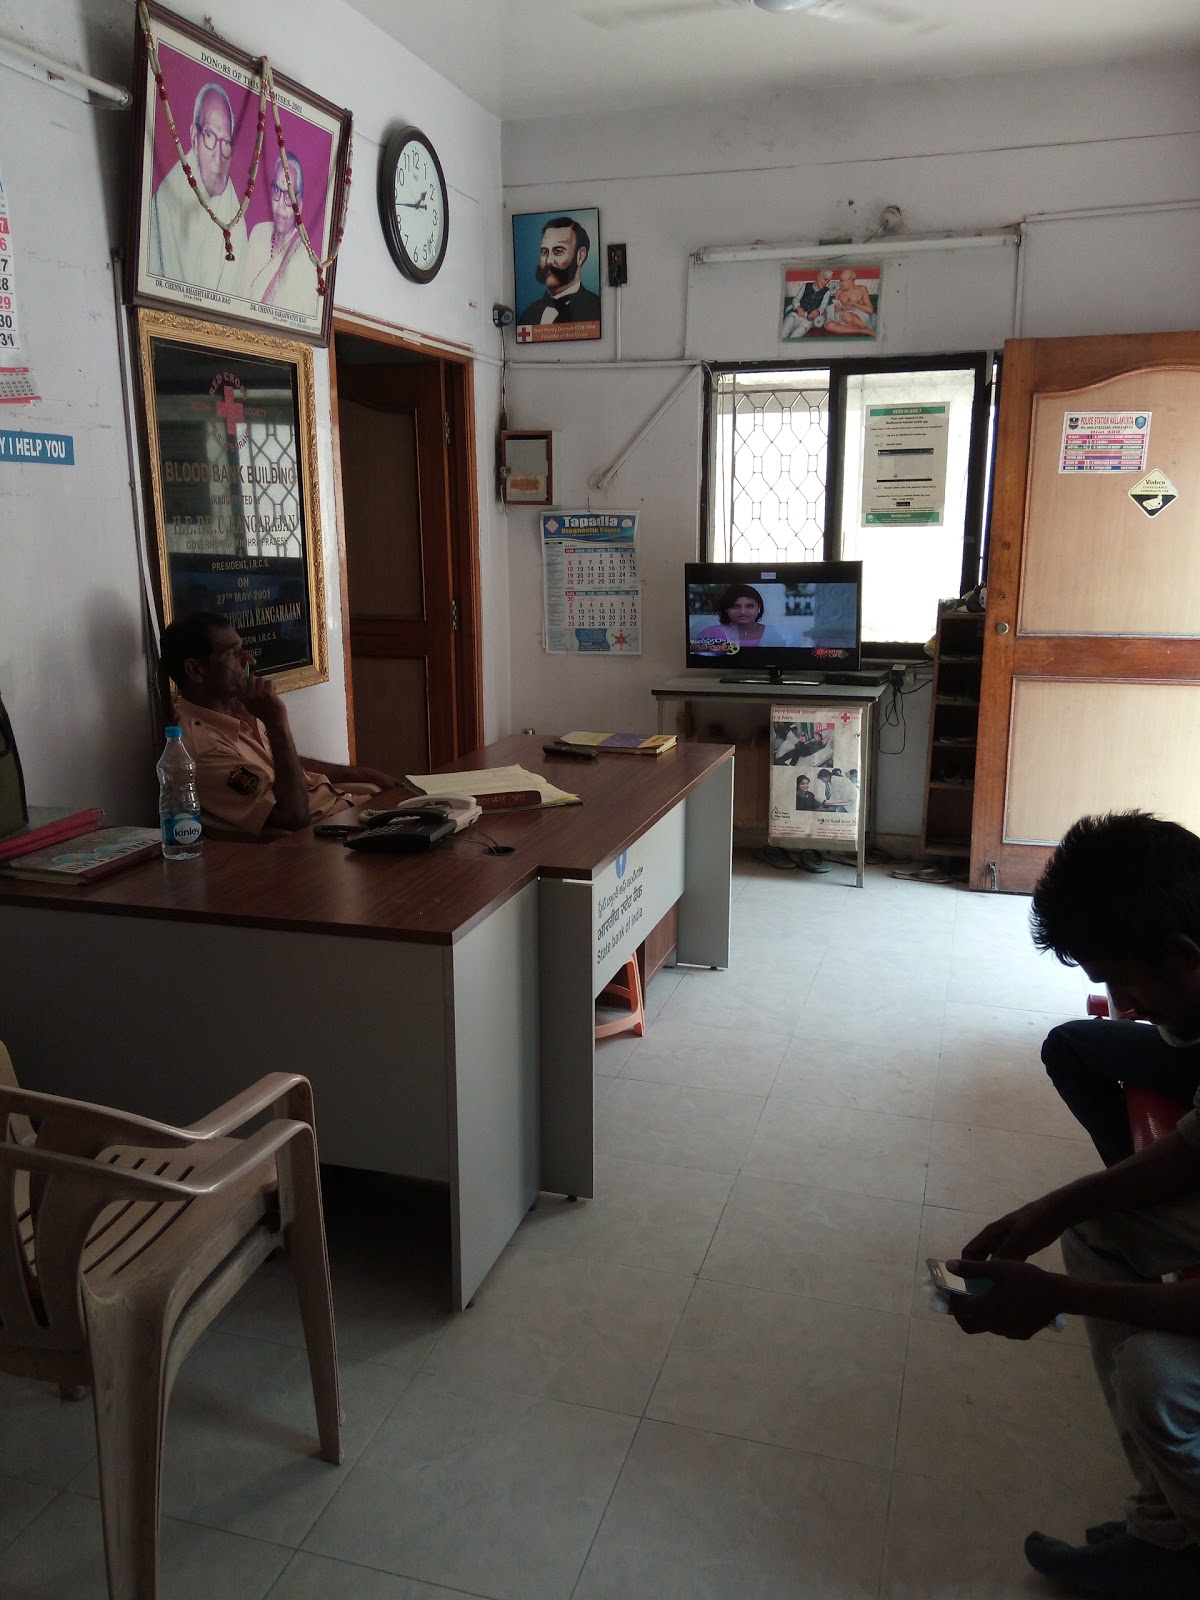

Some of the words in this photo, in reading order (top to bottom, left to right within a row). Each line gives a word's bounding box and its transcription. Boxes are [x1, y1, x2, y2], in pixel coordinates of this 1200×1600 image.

[201, 52, 231, 74] DONORS
[232, 70, 241, 80] OF
[243, 75, 259, 90] THIS
[403, 152, 410, 172] 11
[411, 150, 419, 170] 12
[396, 167, 405, 186] 10
[155, 280, 165, 288] DR.
[164, 281, 185, 293] CHENNA
[222, 296, 231, 305] RAO
[0, 314, 12, 329] 30
[0, 333, 14, 347] 31
[9, 437, 13, 455] I
[16, 438, 42, 456] HELP
[45, 440, 65, 458] YOU
[165, 461, 210, 482] BLOOD
[247, 466, 296, 484] BUILDING
[563, 516, 618, 528] Tapadia
[237, 577, 249, 588] ON
[234, 592, 250, 603] MAY
[253, 588, 271, 600] 2001
[255, 602, 302, 626] RANGARAJAN
[175, 827, 201, 838] kinley
[598, 908, 619, 941] भारतीय
[620, 894, 633, 915] स्टेट
[597, 943, 611, 965] State
[611, 926, 624, 947] bank
[625, 917, 631, 932] of
